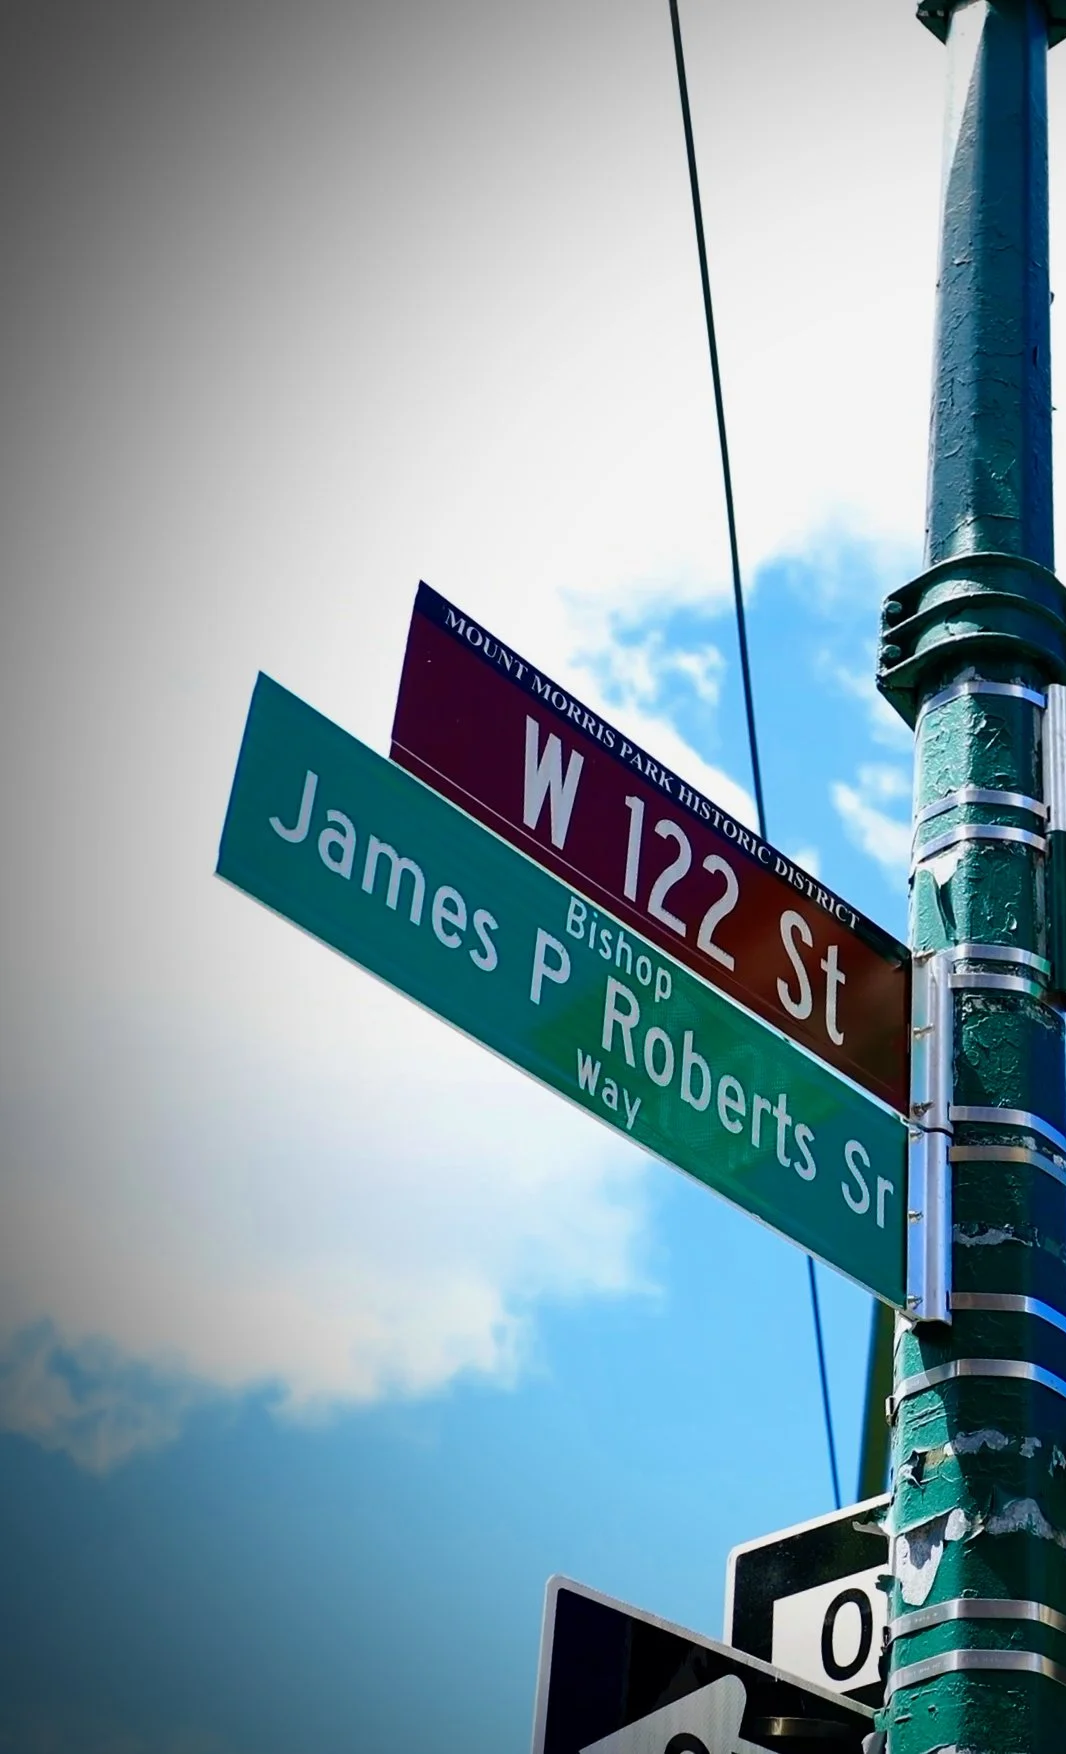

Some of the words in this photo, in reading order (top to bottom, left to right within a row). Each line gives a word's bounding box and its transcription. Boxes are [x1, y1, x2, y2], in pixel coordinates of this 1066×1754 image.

[445, 609, 528, 680] MOUNT
[531, 675, 616, 749] MORRIS
[619, 740, 674, 792] PARK
[678, 785, 770, 864] HISTORIC
[774, 857, 860, 930] DISTRICT
[523, 714, 584, 850] W
[624, 795, 739, 972] 122
[776, 909, 846, 1046] St
[268, 769, 499, 973] James
[529, 927, 572, 1005] P
[602, 975, 817, 1181] Roberts
[841, 1139, 895, 1229] Sr
[565, 896, 673, 1003] Bishop
[577, 1048, 642, 1131] Way
